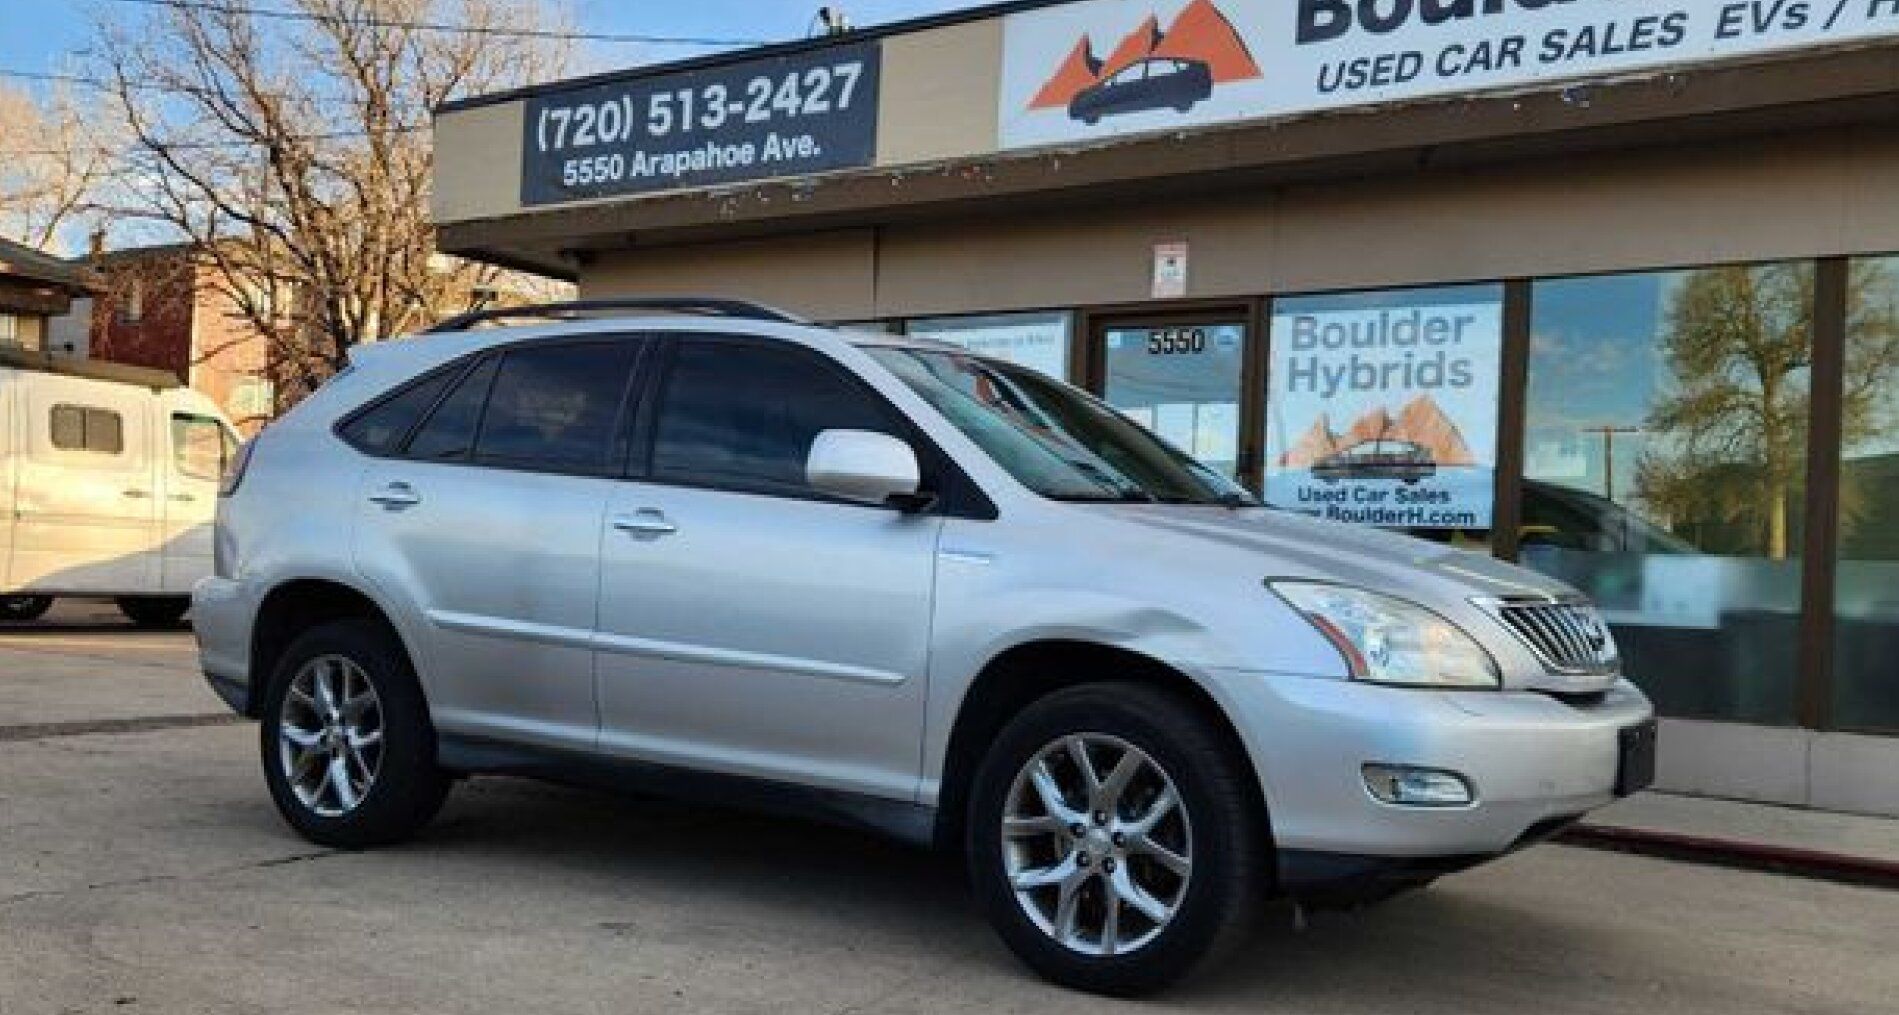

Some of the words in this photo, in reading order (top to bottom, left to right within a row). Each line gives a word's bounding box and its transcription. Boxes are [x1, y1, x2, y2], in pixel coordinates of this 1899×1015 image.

[1317, 51, 1424, 93] USED
[1435, 35, 1527, 78] CAR
[1538, 10, 1690, 62] SALES
[1714, 0, 1811, 39] EVs
[537, 94, 634, 151] (720)
[647, 61, 863, 136] 513-2427
[563, 154, 625, 186] 5550
[630, 141, 753, 178] Arapahoe
[760, 132, 822, 162] Ave.
[1148, 328, 1206, 355] 5550
[1290, 310, 1477, 351] Boulder
[1287, 351, 1475, 399] Hybrids
[1297, 485, 1347, 503] Used
[1353, 485, 1391, 504] Car
[1394, 486, 1452, 505] Sales
[1310, 503, 1478, 525] BoulderH.com
